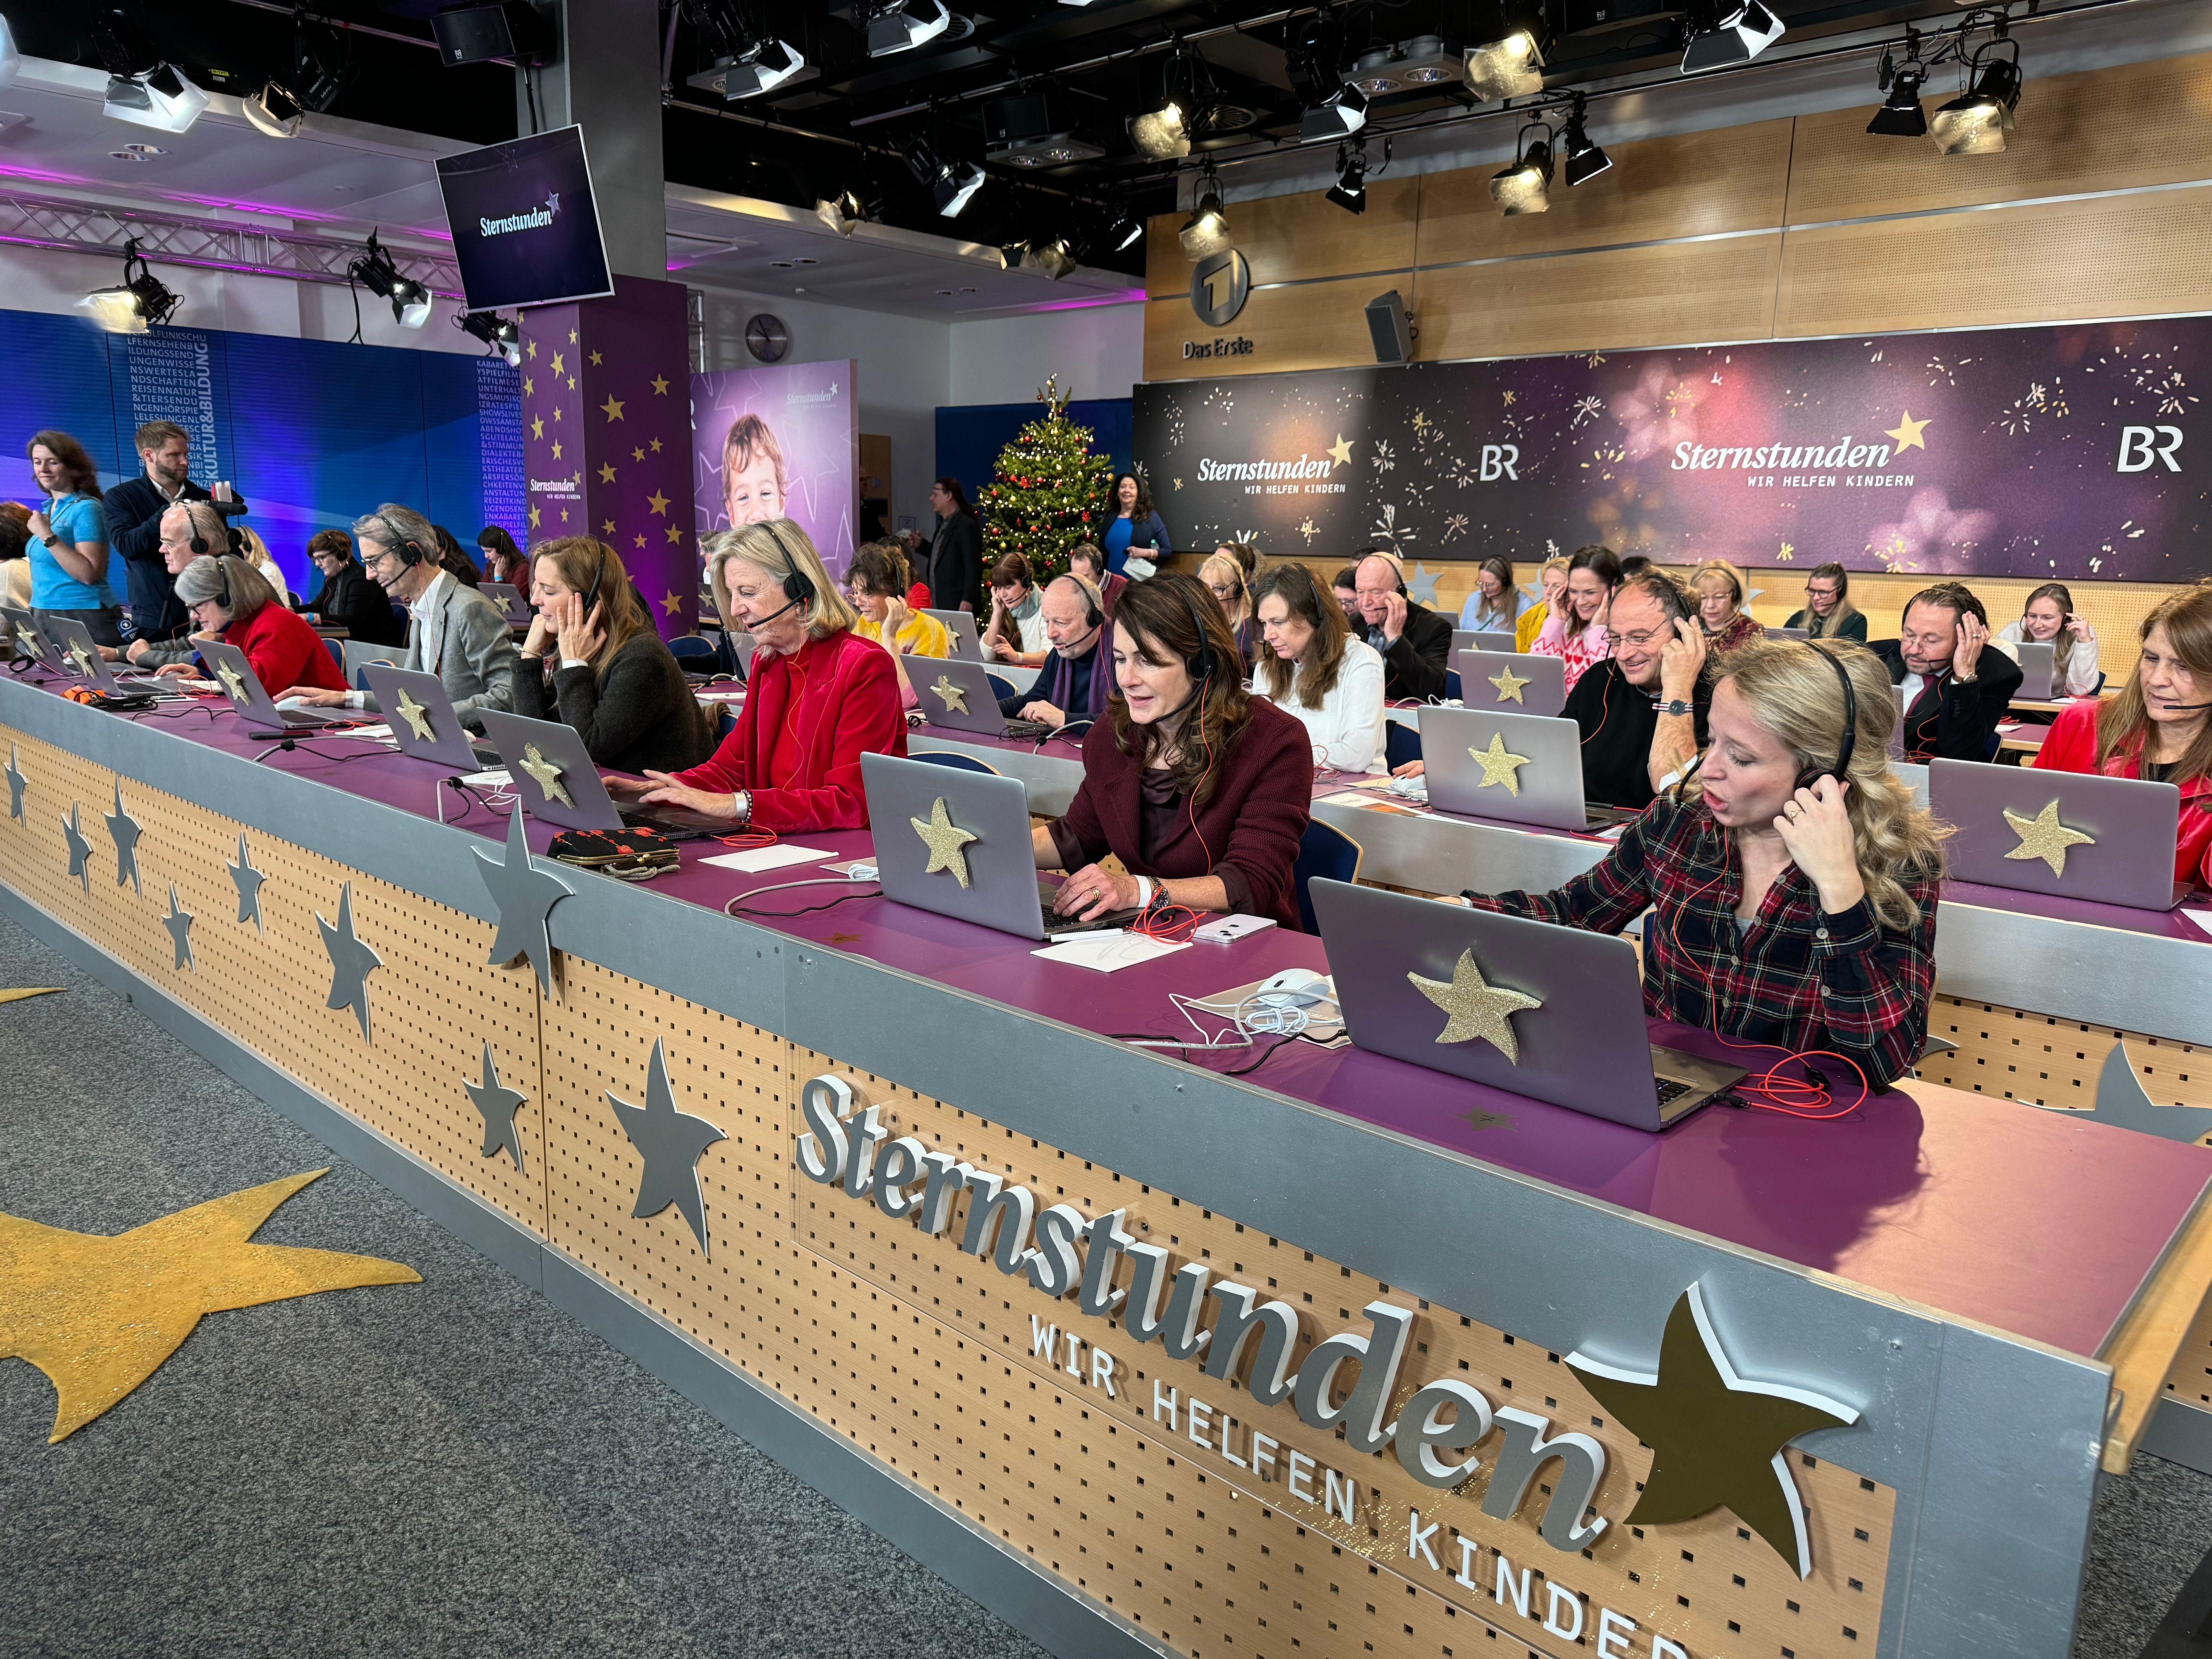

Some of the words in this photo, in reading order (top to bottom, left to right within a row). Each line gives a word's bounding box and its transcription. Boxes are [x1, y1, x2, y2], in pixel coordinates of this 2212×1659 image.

[480, 206, 552, 237] Sternstunden
[127, 337, 193, 350] LFERNSEHENB
[1183, 341, 1211, 359] Das
[1214, 337, 1254, 357] Erste
[128, 347, 194, 359] ILDUNGSSEND
[129, 356, 194, 368] UNGENWISSE
[130, 366, 196, 378] NSWERTESLA
[477, 368, 520, 378] YSPIELFILM
[131, 375, 196, 387] NDSCHAFTEN
[132, 385, 197, 396] REISENNATUR
[132, 393, 198, 405] &TIERSENDU
[787, 390, 831, 405] Sternstunden
[133, 403, 198, 414] NGENHÖRSPIE
[194, 342, 219, 479] KULTUR&BILDUNG
[134, 413, 200, 423] LELESUNGENL
[480, 425, 522, 434] ABENDSHO
[1670, 435, 1890, 470] Sternstunden
[2117, 426, 2183, 472] BR
[1197, 453, 1331, 481] Sternstunden
[1480, 445, 1518, 481] BR
[530, 478, 575, 492] Sternstunden
[1748, 476, 1774, 487] WIR
[1783, 476, 1836, 487] HELFEN
[1846, 475, 1914, 487] KINDERN
[484, 489, 526, 497] ANSTALTUN
[1245, 485, 1261, 495] WIR
[1266, 484, 1299, 494] HELFEN
[1304, 484, 1346, 493] KINDERN
[796, 1074, 1608, 1552] Sternstunden
[1031, 1314, 1115, 1396] WIR
[1153, 1379, 1355, 1525] HELFEN
